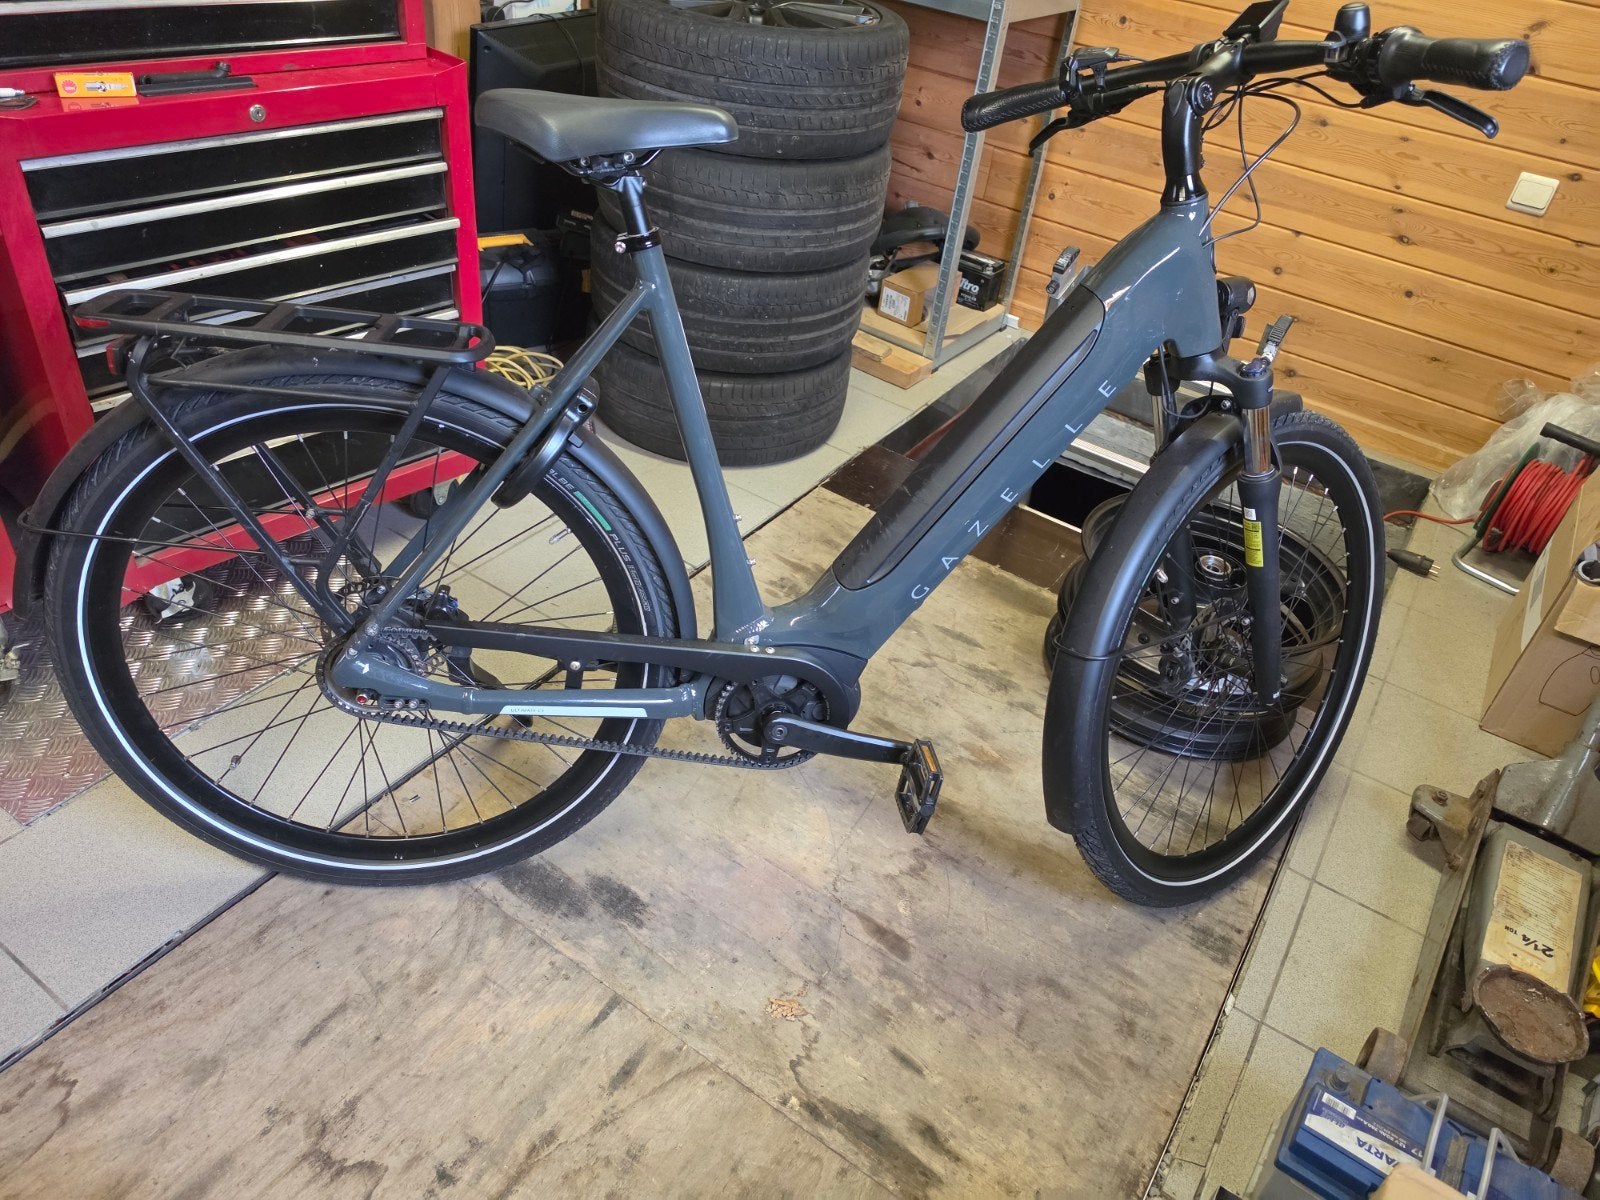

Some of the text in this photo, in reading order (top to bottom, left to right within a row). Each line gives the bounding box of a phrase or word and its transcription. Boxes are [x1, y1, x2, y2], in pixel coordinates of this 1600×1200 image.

[911, 380, 1117, 600] GAZELLE
[609, 533, 631, 562] PLUS
[1356, 1136, 1398, 1166] ARTA
